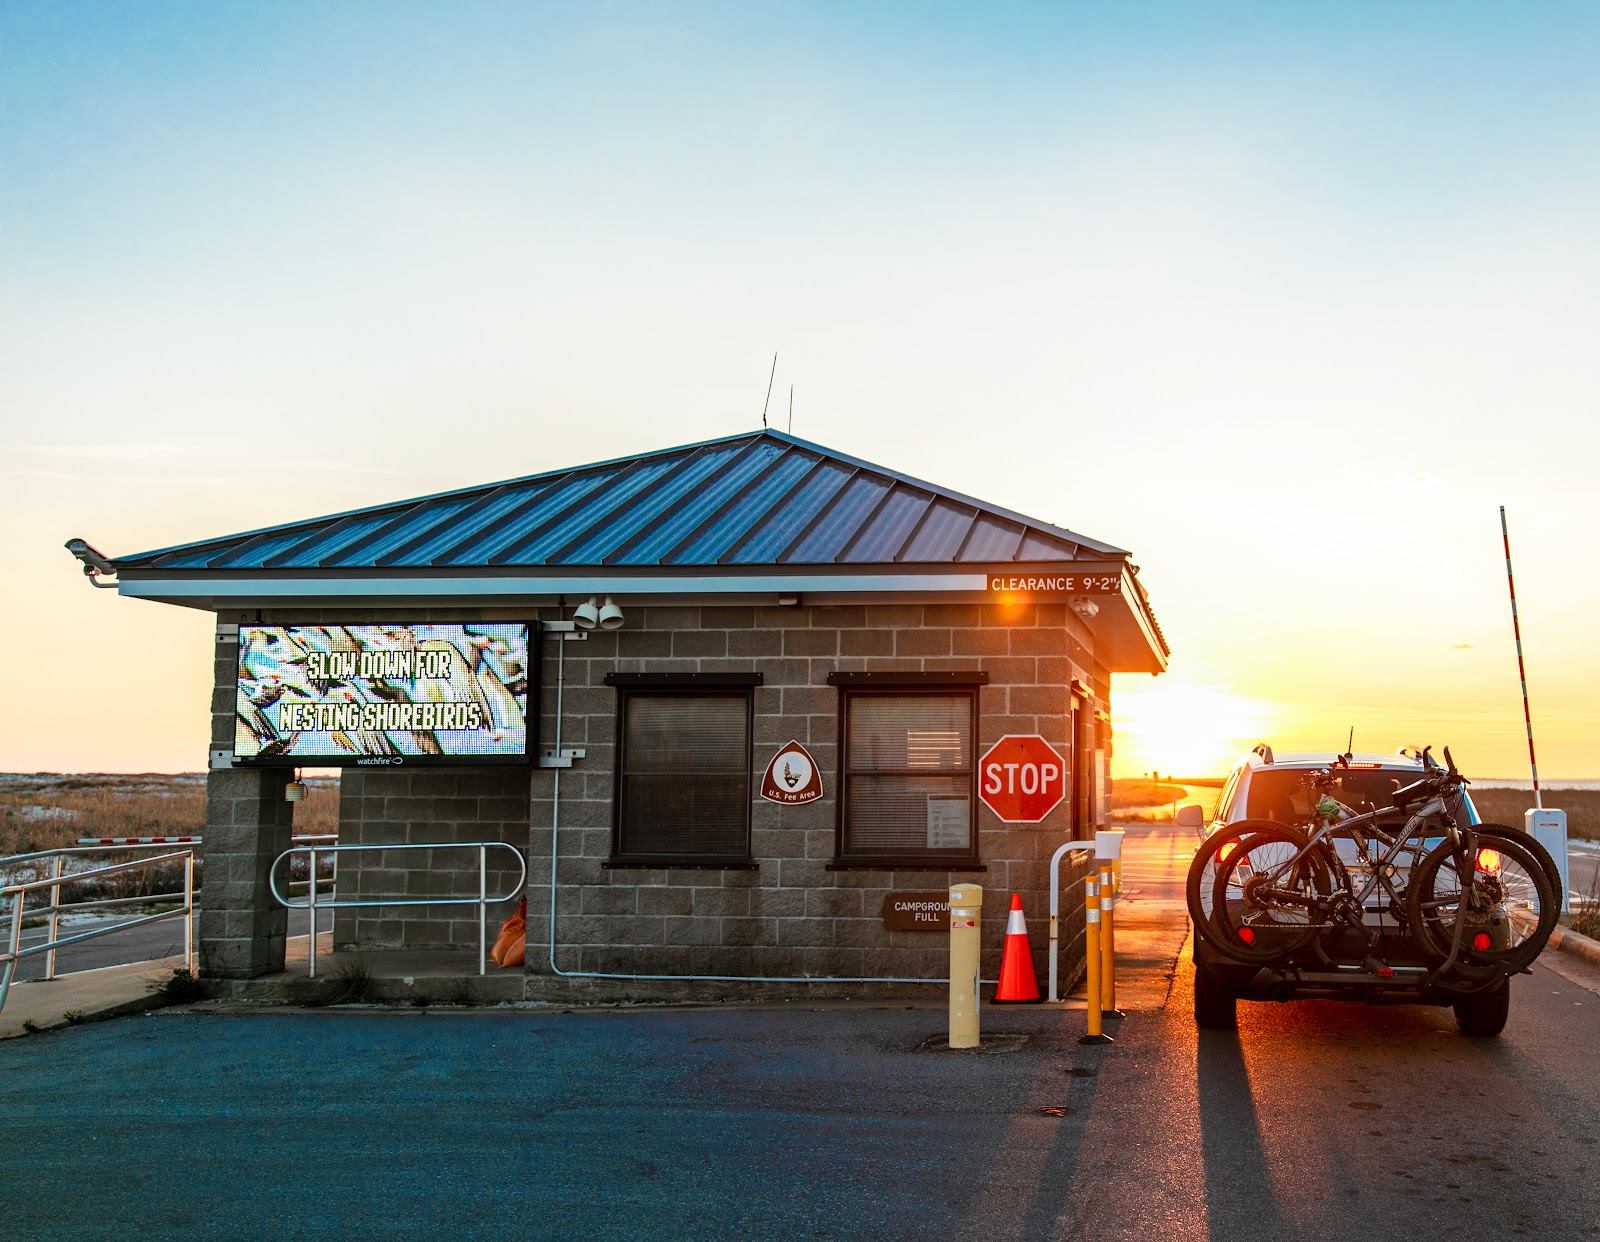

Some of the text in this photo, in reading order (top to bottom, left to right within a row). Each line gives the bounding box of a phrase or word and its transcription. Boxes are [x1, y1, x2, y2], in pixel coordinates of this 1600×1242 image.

[991, 577, 1074, 591] CLEARANCE
[307, 651, 451, 679] SLOW DOWN FOR
[279, 702, 481, 731] NESTING SHOREBIRDS
[357, 756, 391, 765] watchfire
[985, 763, 1059, 795] STOP
[768, 789, 816, 801] U.S. Fee Area
[894, 902, 950, 911] CAMPGROU
[915, 912, 940, 922] FULL
